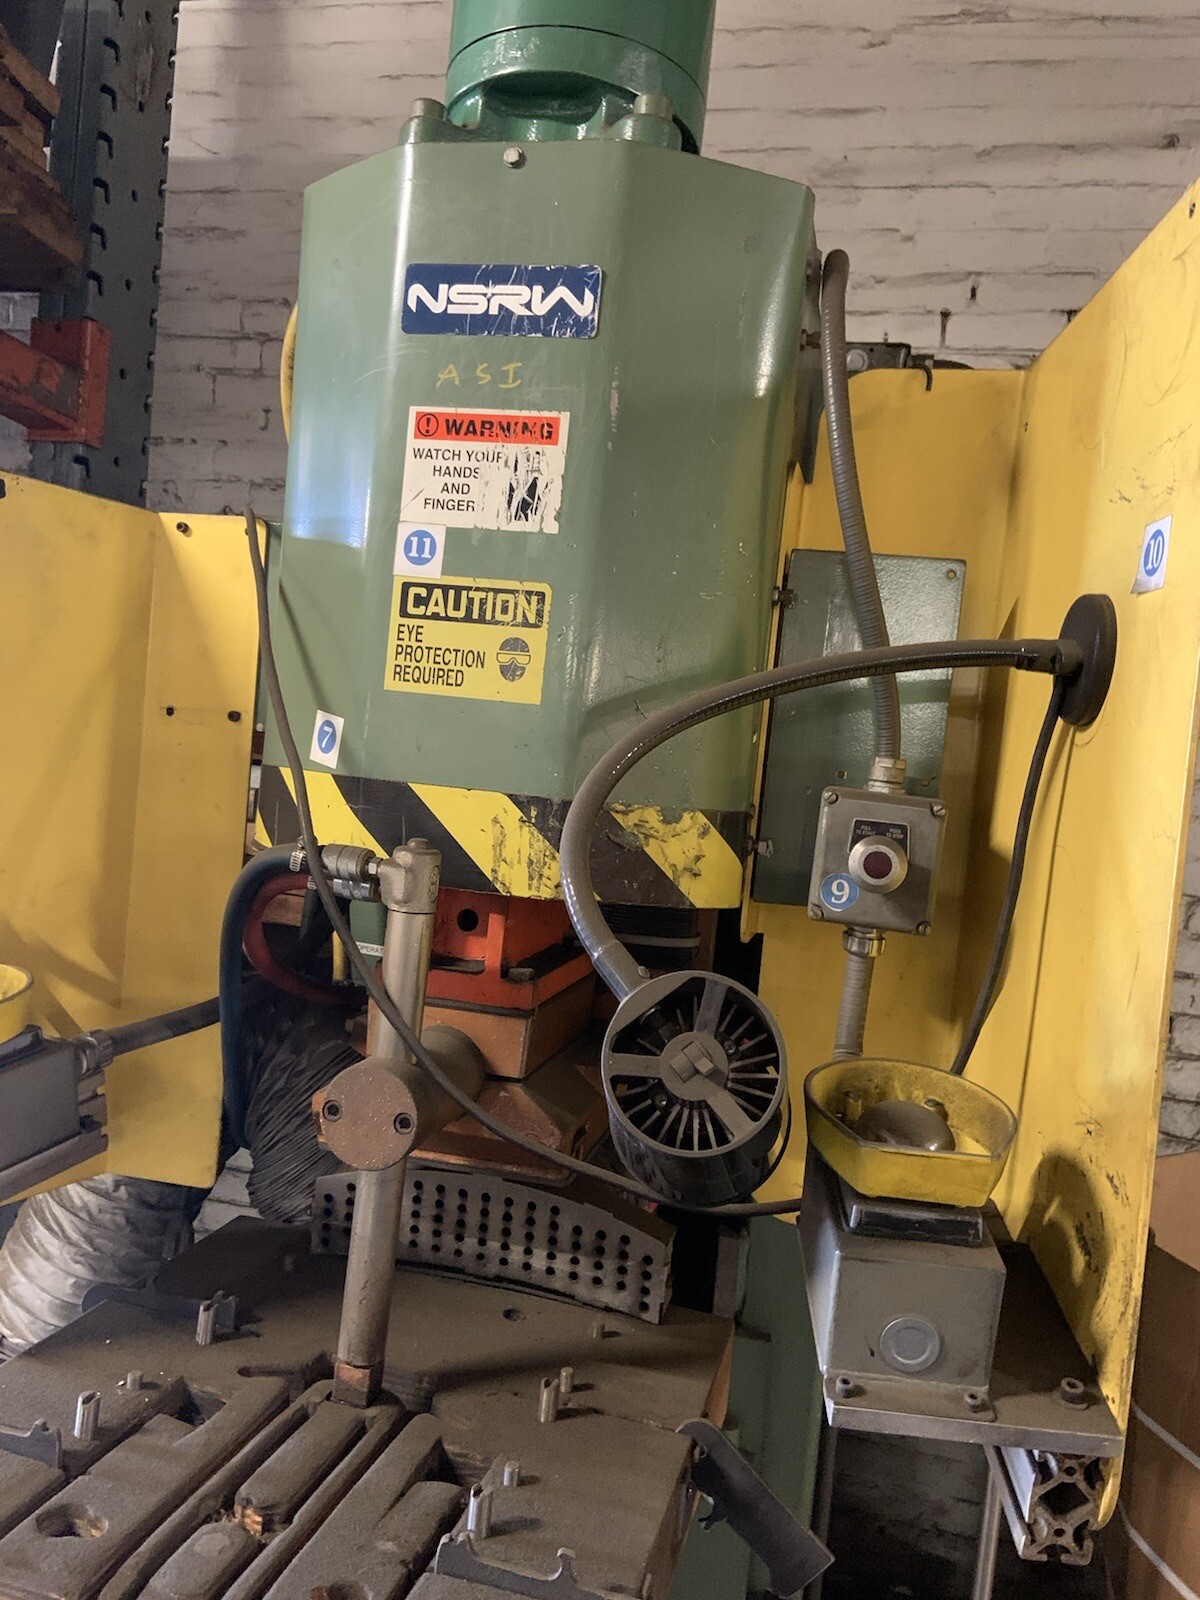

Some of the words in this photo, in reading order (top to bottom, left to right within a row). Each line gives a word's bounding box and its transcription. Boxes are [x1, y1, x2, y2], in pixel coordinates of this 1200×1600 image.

[413, 447, 461, 462] WATCH
[432, 465, 480, 479] HANDS
[441, 483, 470, 495] AND
[408, 536, 432, 559] 11
[1145, 536, 1163, 570] 10
[406, 586, 538, 624] CAUTION
[396, 624, 424, 643] EYE
[395, 644, 486, 669] PROTECTION
[393, 664, 464, 687] REQUIRED
[323, 725, 333, 749] 7
[830, 879, 850, 904] 9
